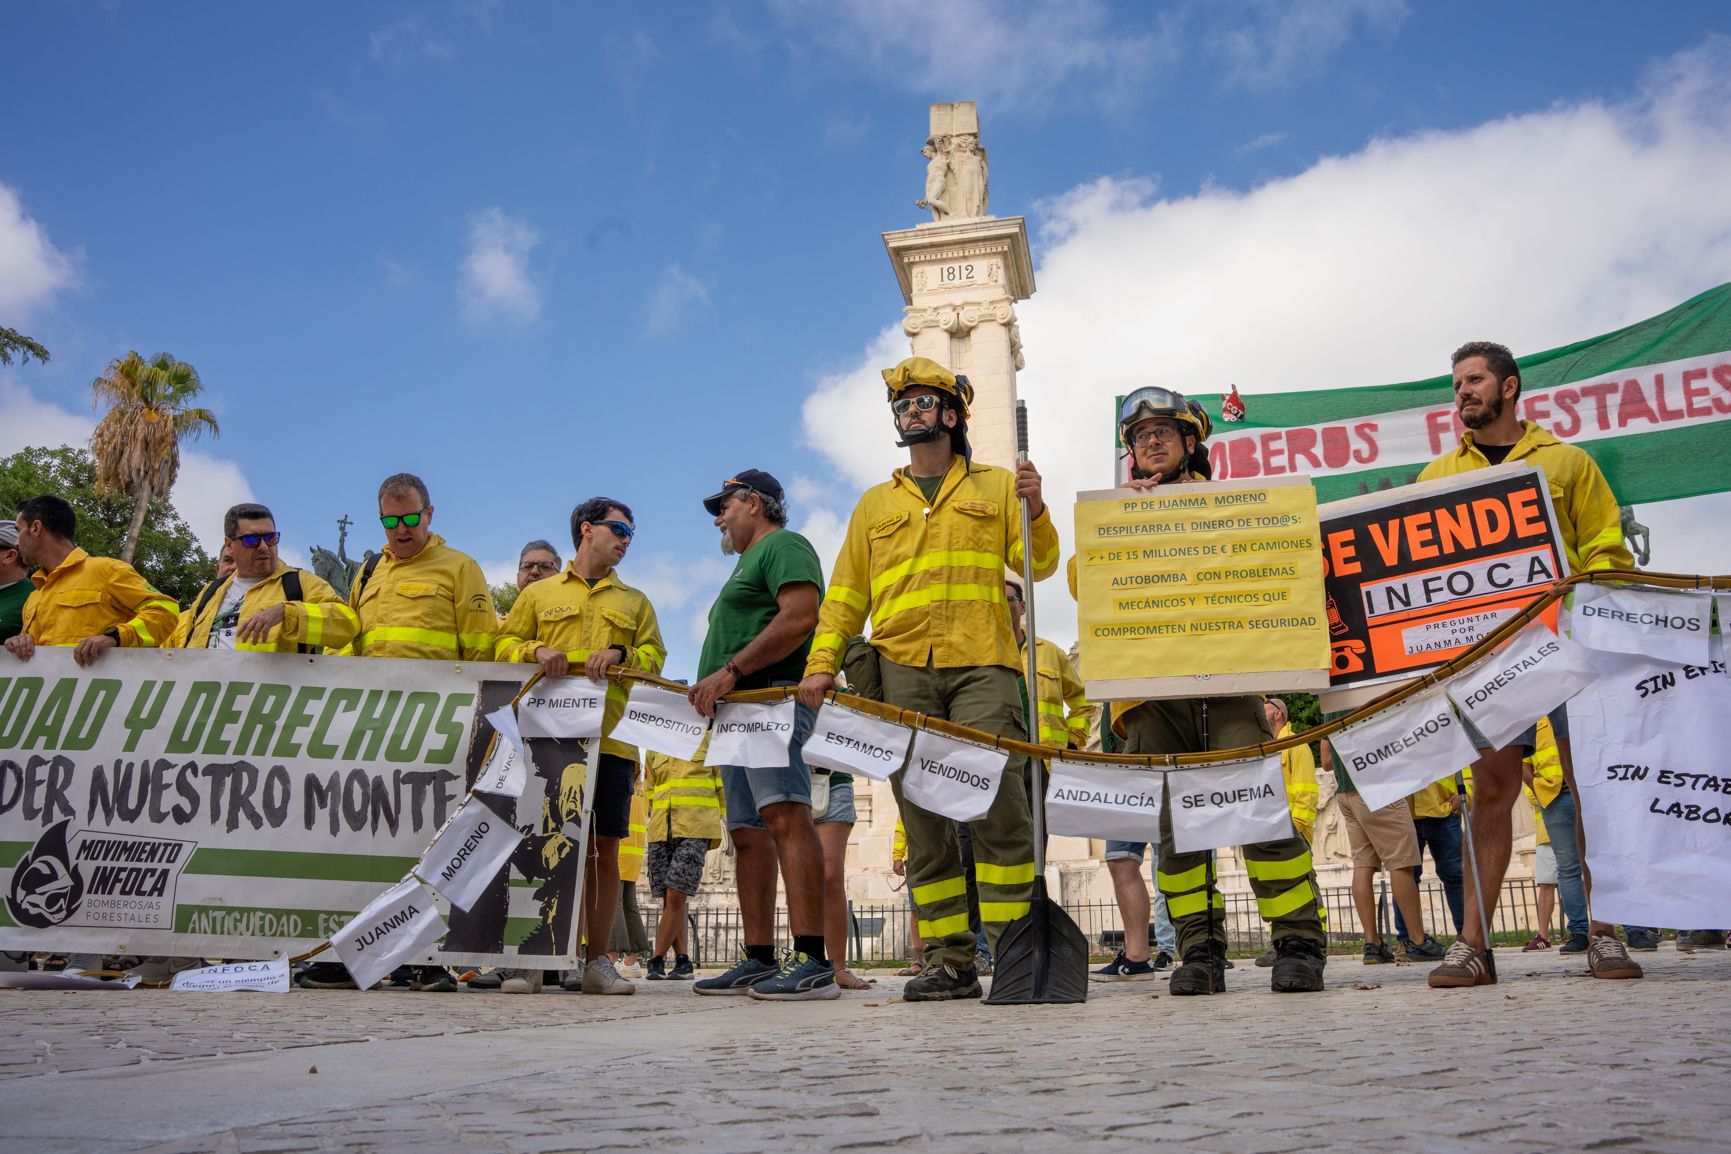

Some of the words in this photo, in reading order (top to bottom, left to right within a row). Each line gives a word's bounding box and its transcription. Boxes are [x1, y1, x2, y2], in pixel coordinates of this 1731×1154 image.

[939, 264, 975, 283] 1812
[1226, 402, 1244, 418] CGT
[1123, 501, 1139, 512] PP
[1140, 500, 1155, 511] DE
[1156, 497, 1207, 510] JUANMA
[1214, 491, 1267, 506] MORENO
[1098, 522, 1172, 537] DESPILFARRA
[1174, 522, 1187, 533] EL
[1190, 517, 1235, 532] DINERO
[1237, 516, 1253, 528] DE
[1255, 513, 1302, 528] TOD@S:
[1367, 487, 1548, 568] VENDE
[1108, 551, 1123, 562] DE
[1126, 549, 1139, 561] 15
[1142, 545, 1200, 560] MILLONES
[1202, 544, 1218, 556] DE
[1219, 543, 1228, 554] €
[1231, 543, 1248, 553] EN
[1250, 537, 1313, 553] CAMIONES
[1111, 571, 1188, 587] AUTOBOMBA
[1196, 570, 1222, 582] CON
[1224, 565, 1296, 581] PROBLEMAS
[1364, 555, 1554, 615] INFOCA
[1118, 596, 1186, 611] MECÁNICOS
[1188, 596, 1196, 607] Y
[1203, 591, 1260, 606] TÉCNICOS
[1262, 591, 1288, 603] QUE
[1093, 623, 1187, 638] COMPROMETEN
[1189, 619, 1244, 633] NUESTRA
[1248, 615, 1317, 631] SEGURIDAD
[1425, 612, 1498, 632] PREGUNTAR
[1450, 625, 1475, 636] POR
[1581, 604, 1701, 632] DERECHOS
[1407, 637, 1462, 654] JUANMA
[1464, 641, 1561, 710] FORESTALES
[1634, 671, 1676, 699] SIN
[527, 697, 546, 708] PP
[548, 697, 598, 710] MIENTE
[0, 676, 123, 751] DAD
[122, 680, 176, 752] Y
[164, 680, 476, 765] DERECHOS
[628, 709, 702, 736] DISPOSITIVO
[716, 721, 791, 735] INCOMPLETO
[825, 731, 894, 763] ESTAMOS
[1352, 712, 1451, 772] BOMBEROS
[496, 775, 507, 790] DE
[919, 756, 991, 791] VENDIDOS
[1606, 764, 1650, 781] SIN
[87, 758, 292, 834] NUESTRO
[1053, 787, 1156, 808] ANDALUCÍA
[1182, 793, 1206, 810] SE
[1209, 783, 1276, 806] QUEMA
[75, 839, 184, 864] MOVIMIENTO
[440, 820, 491, 883] MORENO
[86, 865, 171, 898] INFOCA
[86, 898, 162, 911] BOMBEROS/AS
[86, 911, 160, 924] FORESTALES
[187, 909, 302, 938] ANTIGUEDAD
[355, 903, 421, 953] JUANMA
